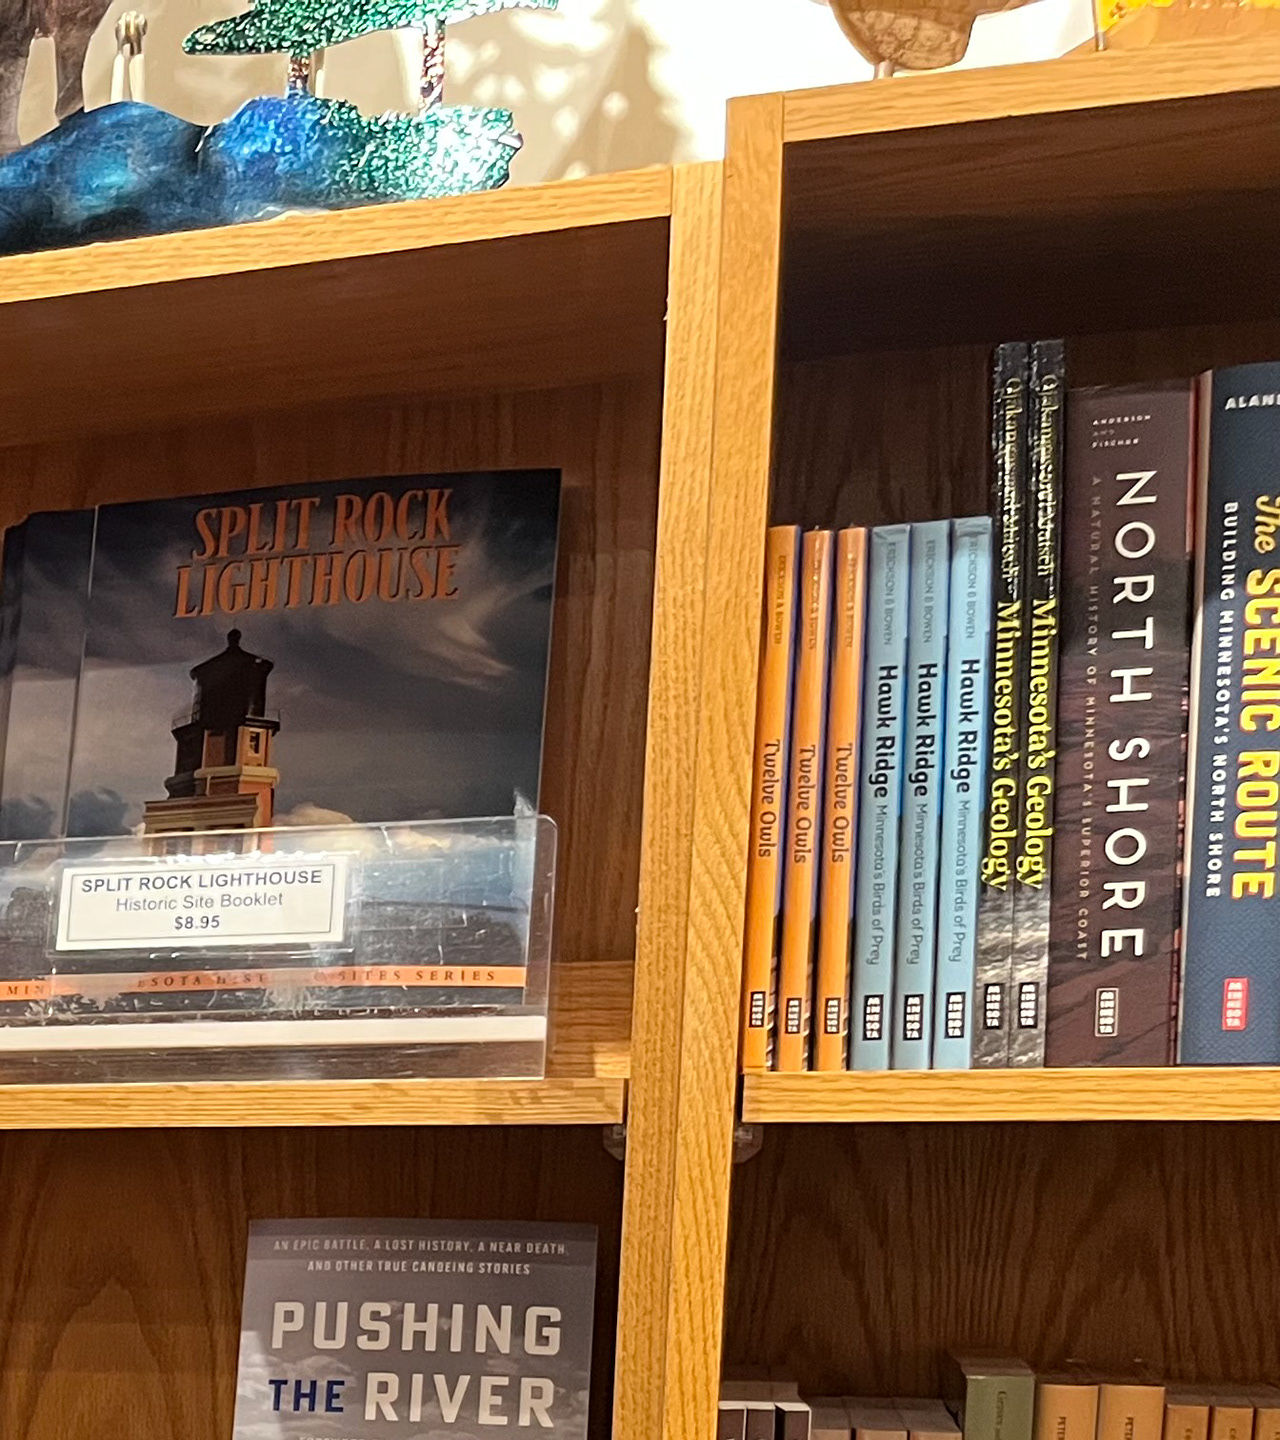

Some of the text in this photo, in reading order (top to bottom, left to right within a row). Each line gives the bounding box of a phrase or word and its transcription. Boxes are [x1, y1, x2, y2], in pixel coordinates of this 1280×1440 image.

[191, 489, 454, 561] SPLIT ROCK
[173, 544, 464, 619] LIGHTHOUSE
[951, 659, 980, 794] Hawk Ridge
[1100, 470, 1158, 958] NORTH SHORE
[1016, 598, 1057, 891] Minnesota's Geology
[759, 739, 780, 858] Twelve Owls
[1231, 751, 1280, 899] ROUTE
[82, 870, 322, 892] SPLIT ROCK LIGHTHOUSE
[116, 892, 283, 911] Historic Site Booklet
[174, 916, 220, 930] $8.95
[416, 970, 495, 981] SERIES
[274, 1240, 288, 1250] AN
[294, 1240, 319, 1250] EPIC
[374, 1240, 381, 1250] A
[386, 1240, 414, 1250] LOST
[478, 1242, 485, 1252] A
[490, 1242, 521, 1252] NEAR
[308, 1261, 530, 1275] AND OTHER TRUE CANOEING STORIES
[271, 1301, 563, 1356] PUSHING
[268, 1372, 554, 1428] THE RIVER
